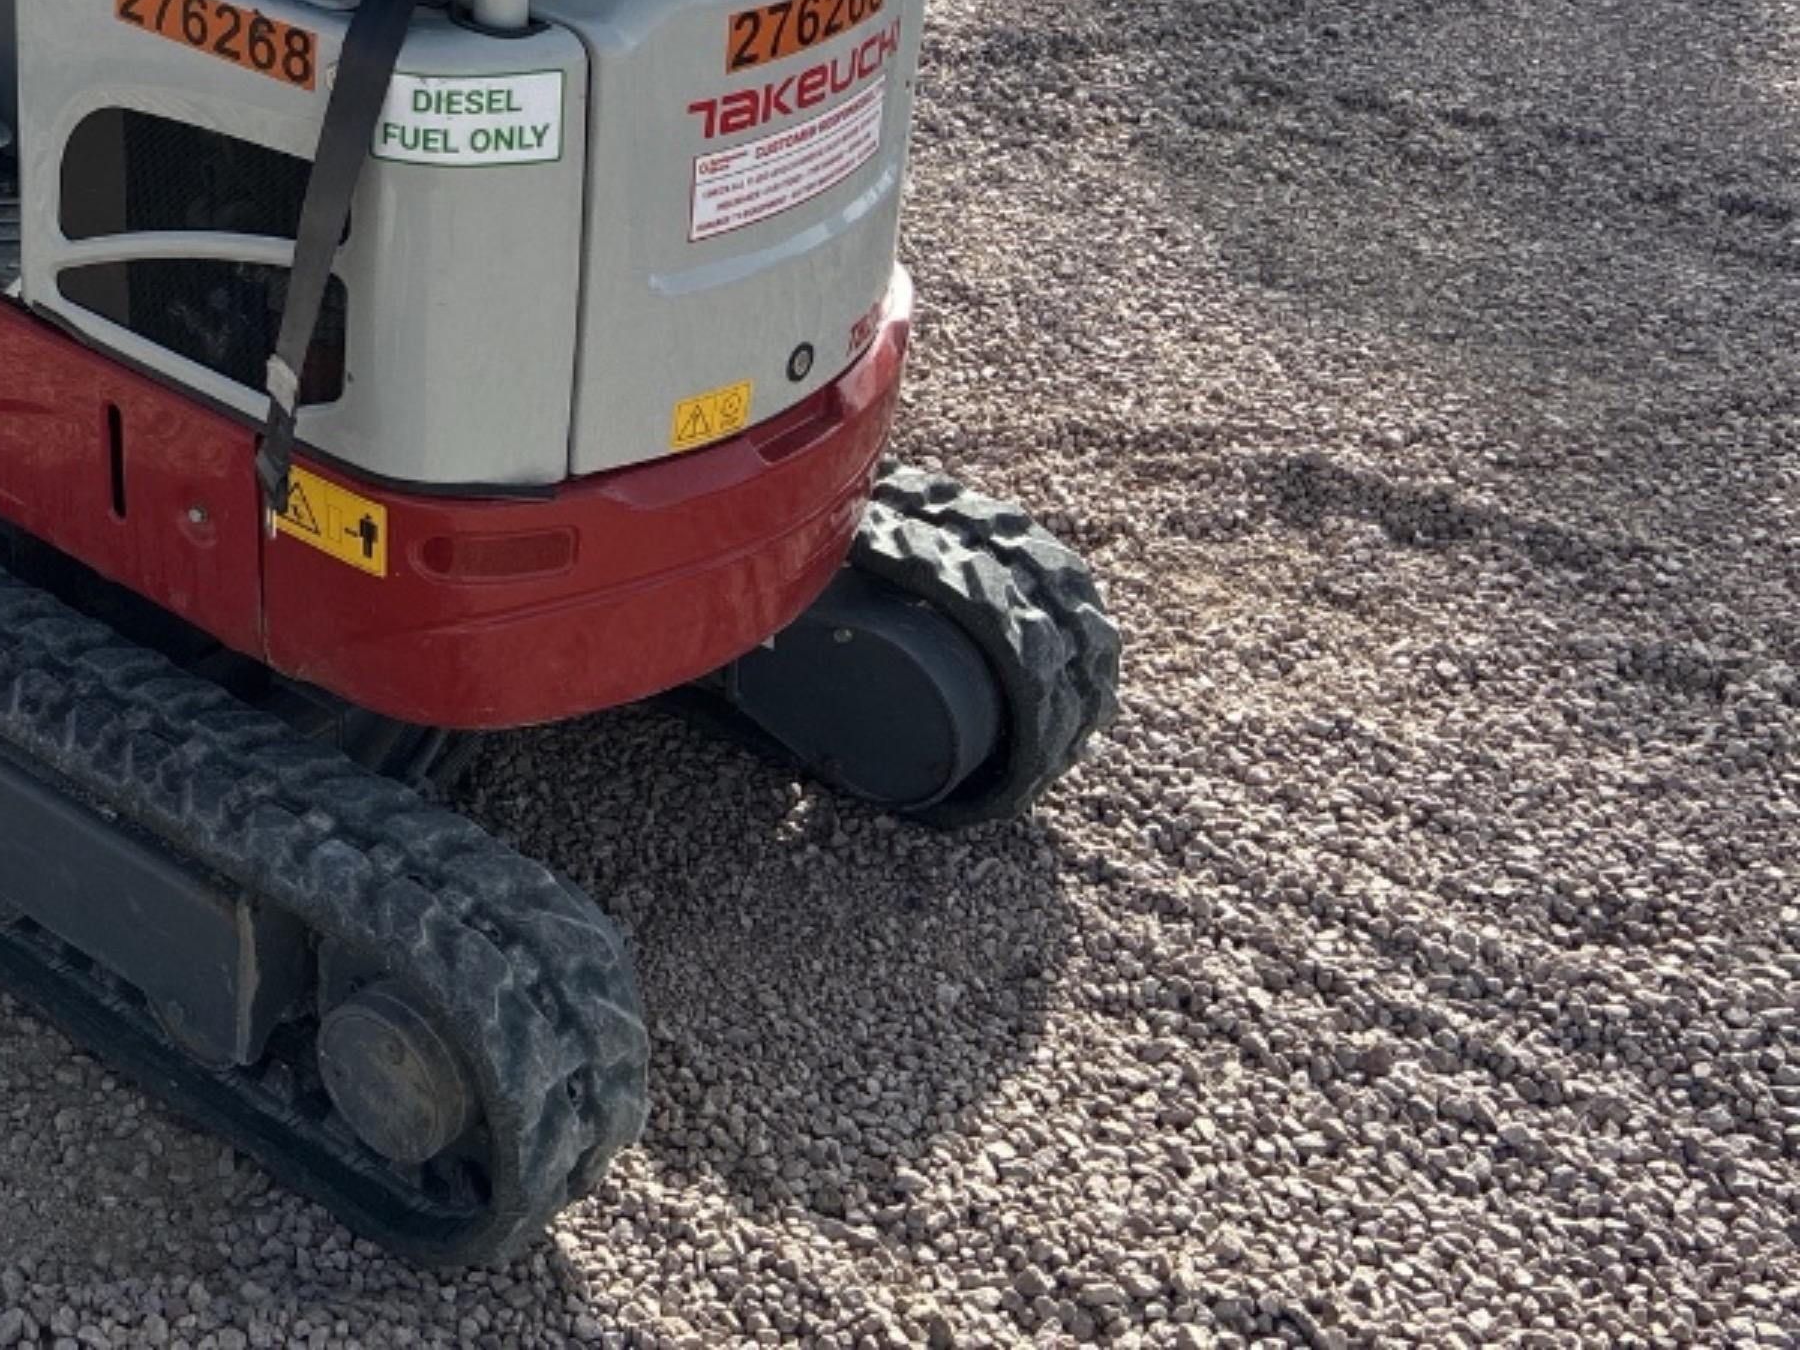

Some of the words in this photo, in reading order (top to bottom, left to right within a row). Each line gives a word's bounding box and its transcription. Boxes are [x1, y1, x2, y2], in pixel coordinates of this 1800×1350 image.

[412, 89, 523, 115] DIESEL
[382, 122, 460, 154] FUEL
[470, 123, 550, 153] ONLY
